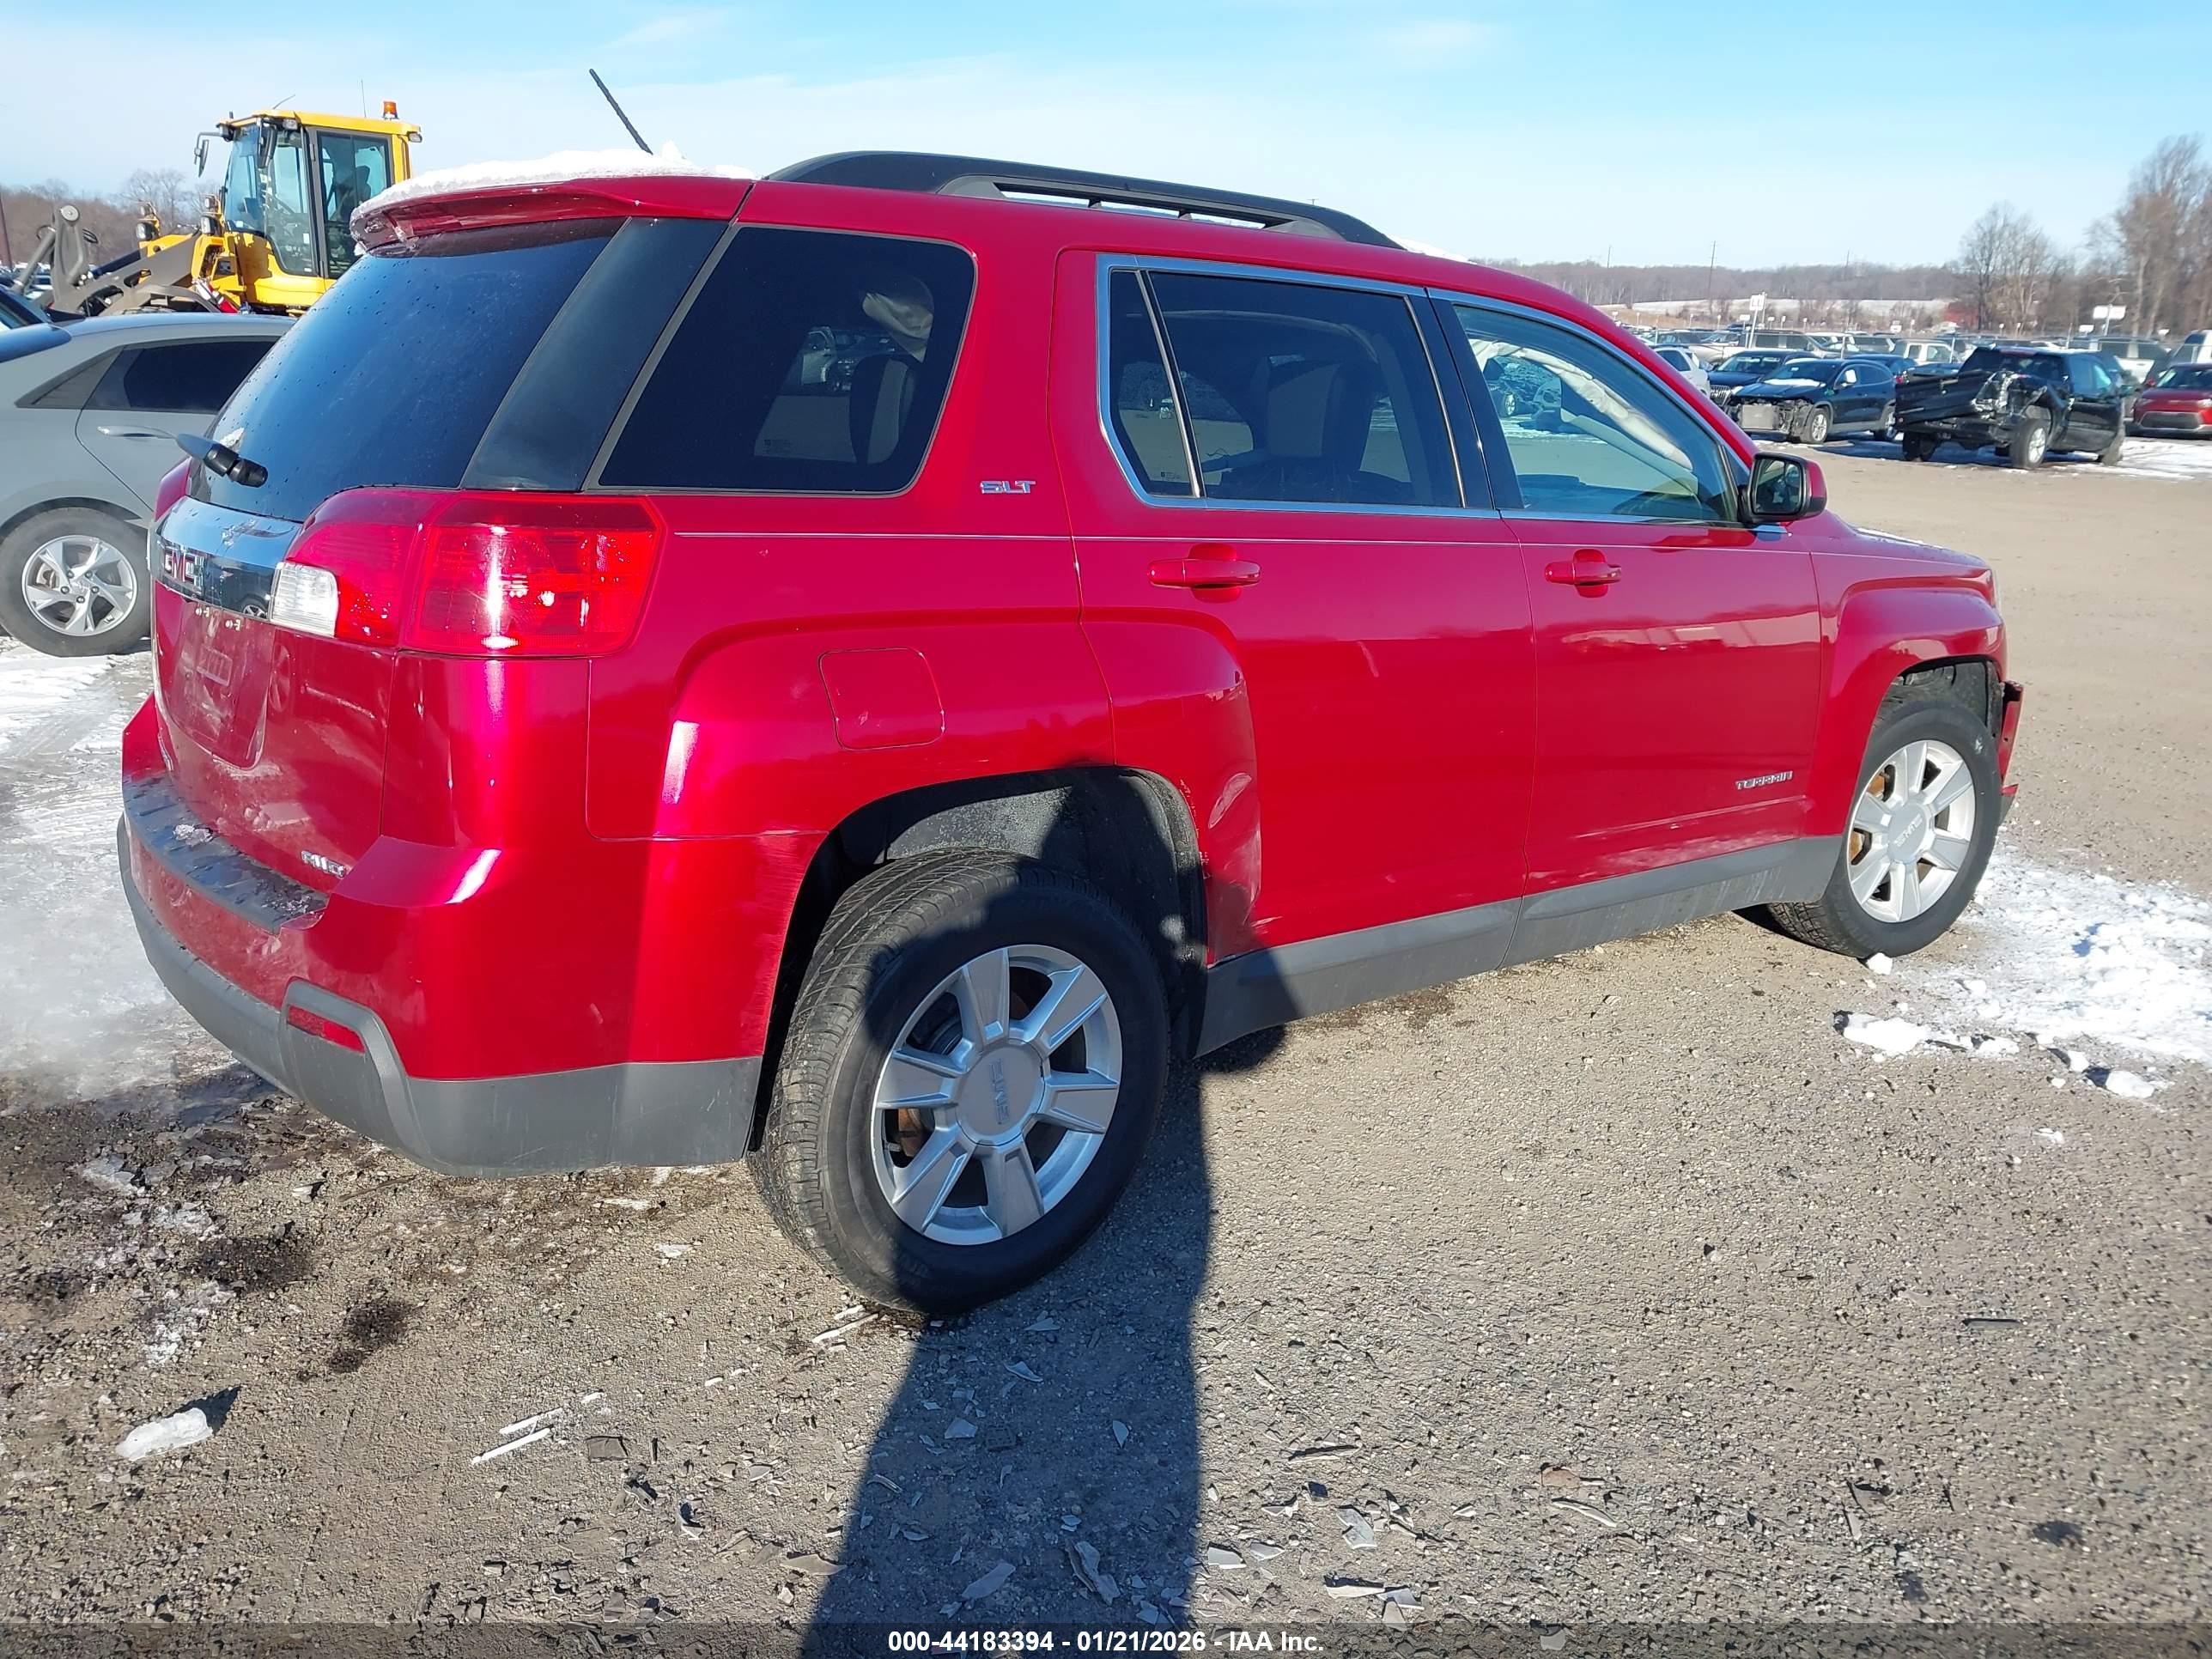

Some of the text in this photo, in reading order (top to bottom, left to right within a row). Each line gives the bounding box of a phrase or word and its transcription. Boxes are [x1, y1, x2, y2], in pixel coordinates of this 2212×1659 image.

[980, 480, 1036, 495] SLT
[163, 545, 204, 592] GMC
[1735, 770, 1794, 790] TERRAIN
